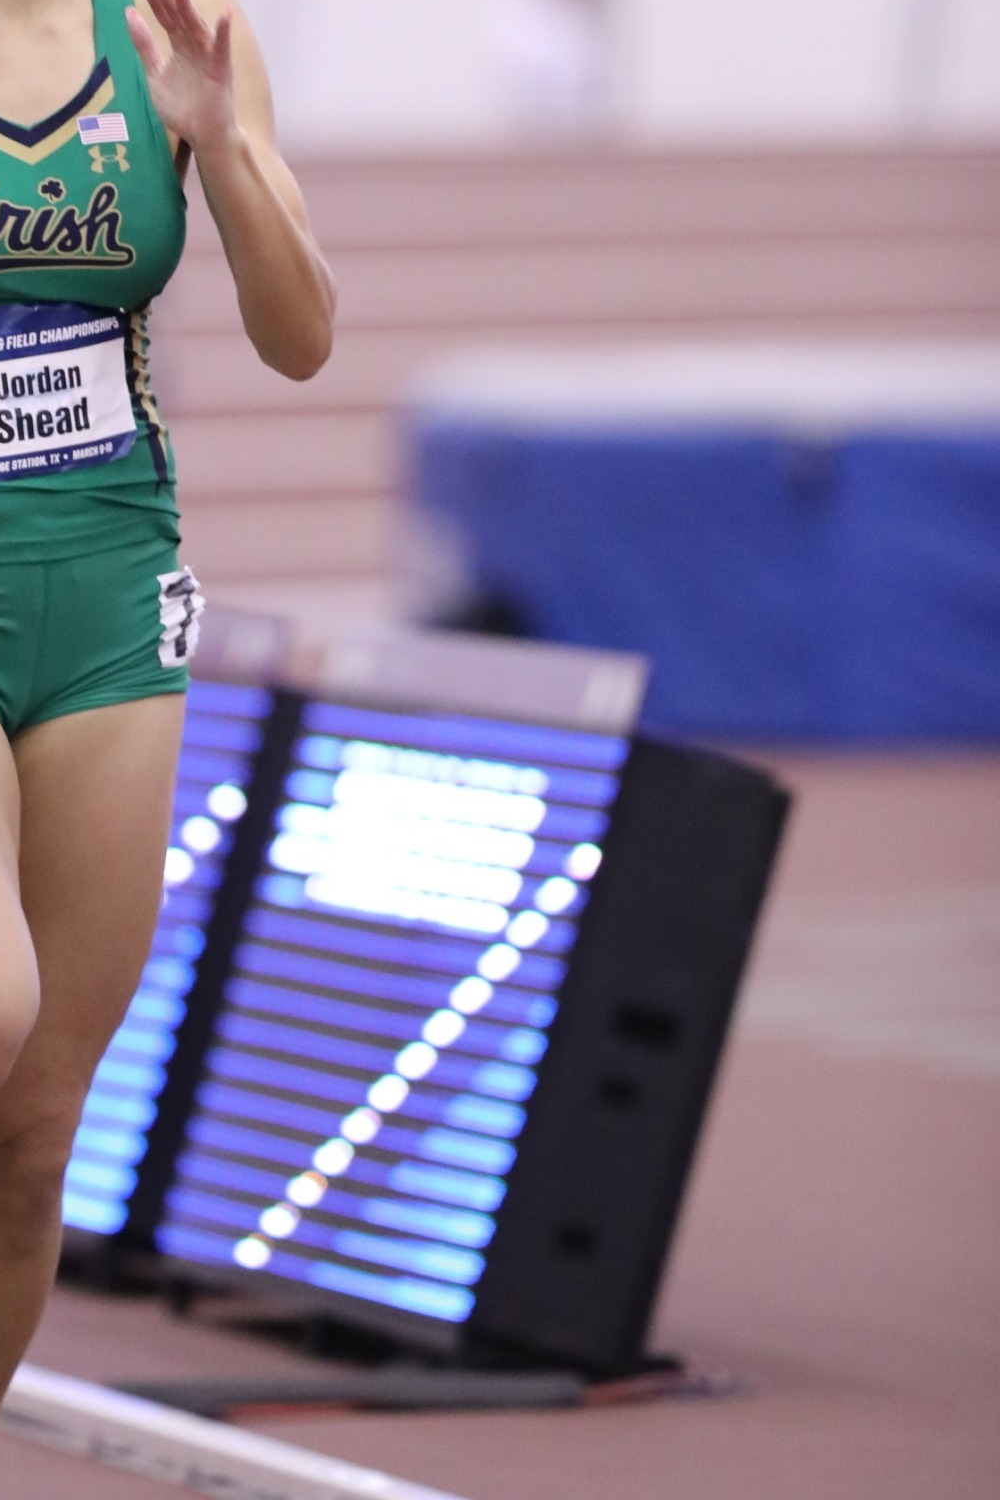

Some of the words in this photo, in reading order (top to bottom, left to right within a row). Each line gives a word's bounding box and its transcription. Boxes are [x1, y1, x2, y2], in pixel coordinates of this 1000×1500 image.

[6, 332, 37, 350] FIELD
[40, 316, 119, 344] CHAMPIONSHIPS
[49, 453, 61, 465] TX
[72, 447, 99, 460] MARCH
